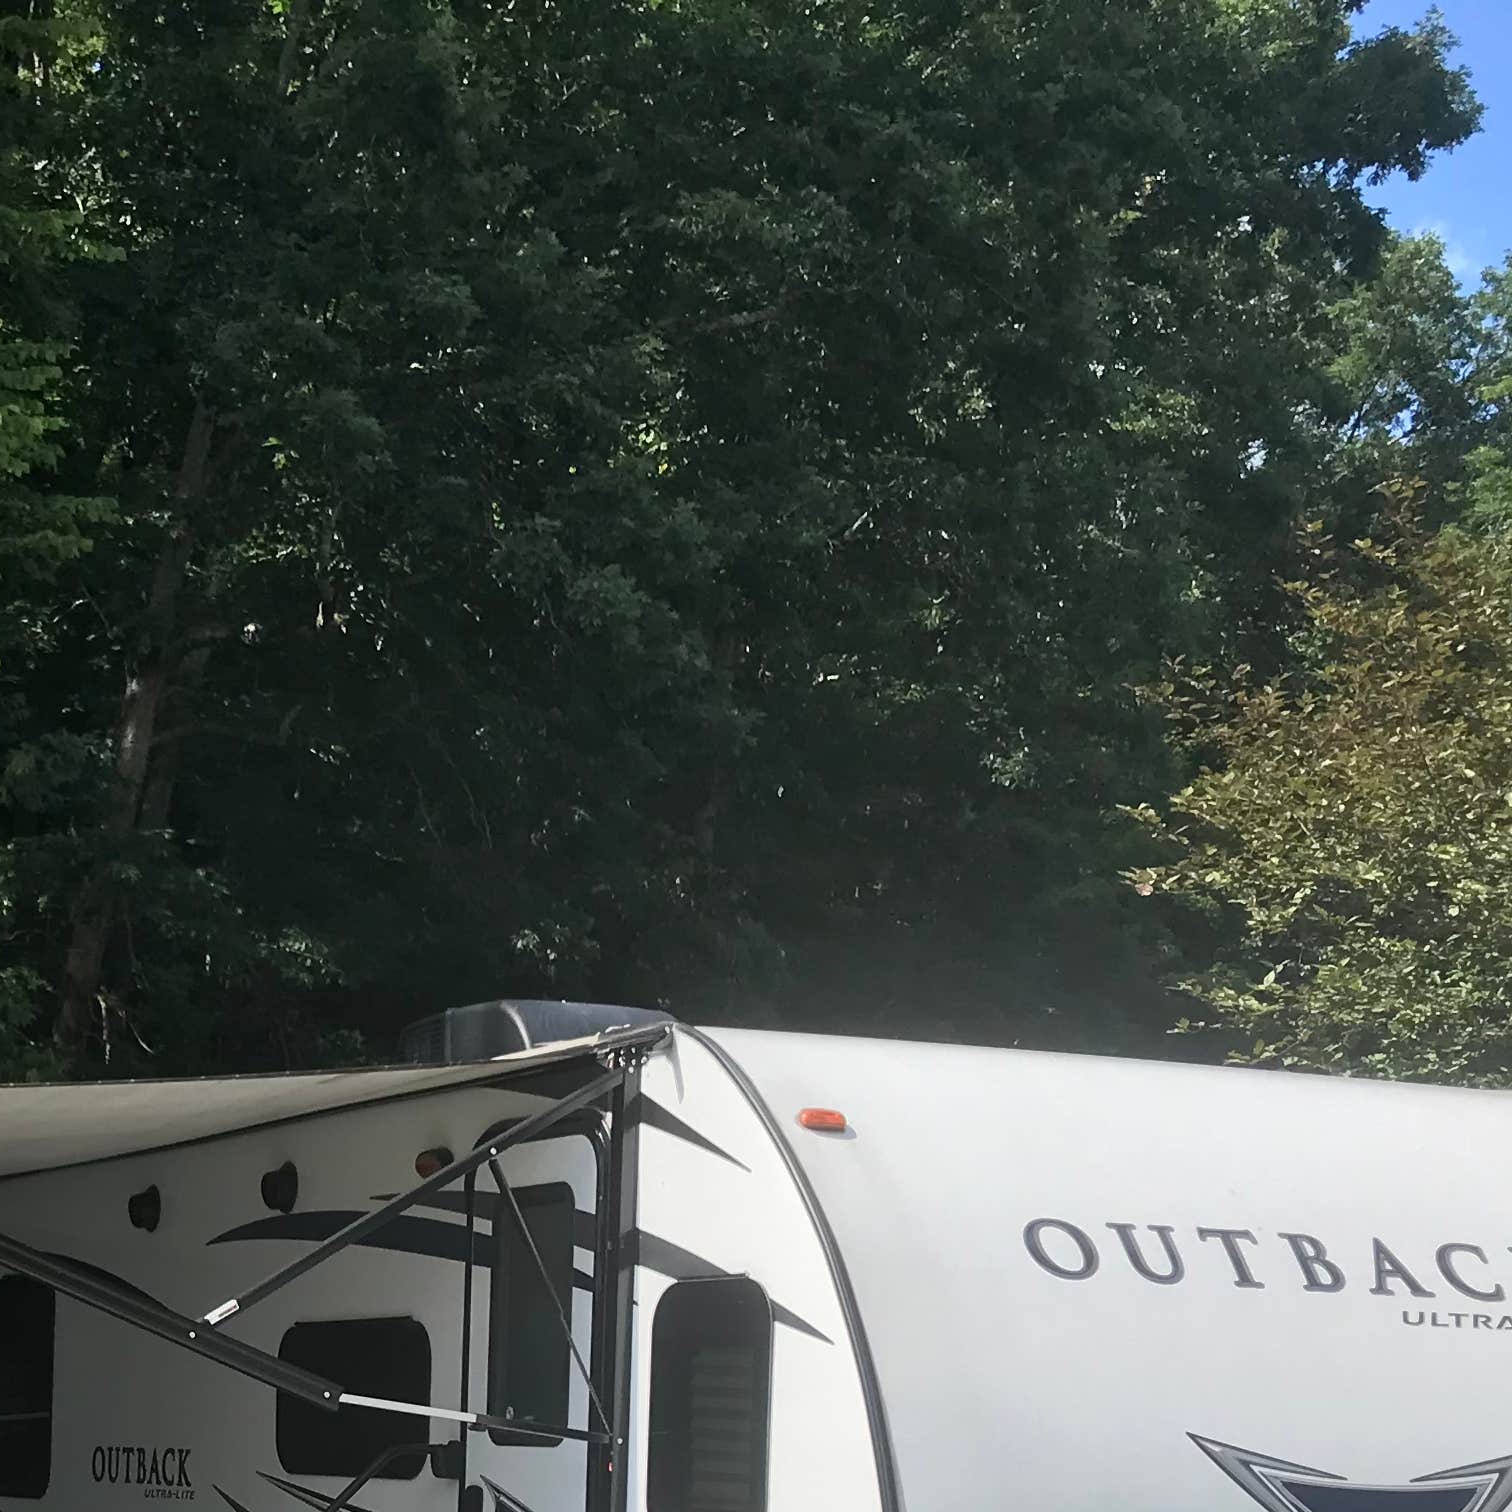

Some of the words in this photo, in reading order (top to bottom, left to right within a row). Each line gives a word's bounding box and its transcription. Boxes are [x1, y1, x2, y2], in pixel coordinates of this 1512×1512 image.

[1022, 1217, 1512, 1303] OUTBAC
[92, 1446, 192, 1487] OUTBACK
[144, 1488, 195, 1500] ULTRA-LITE
